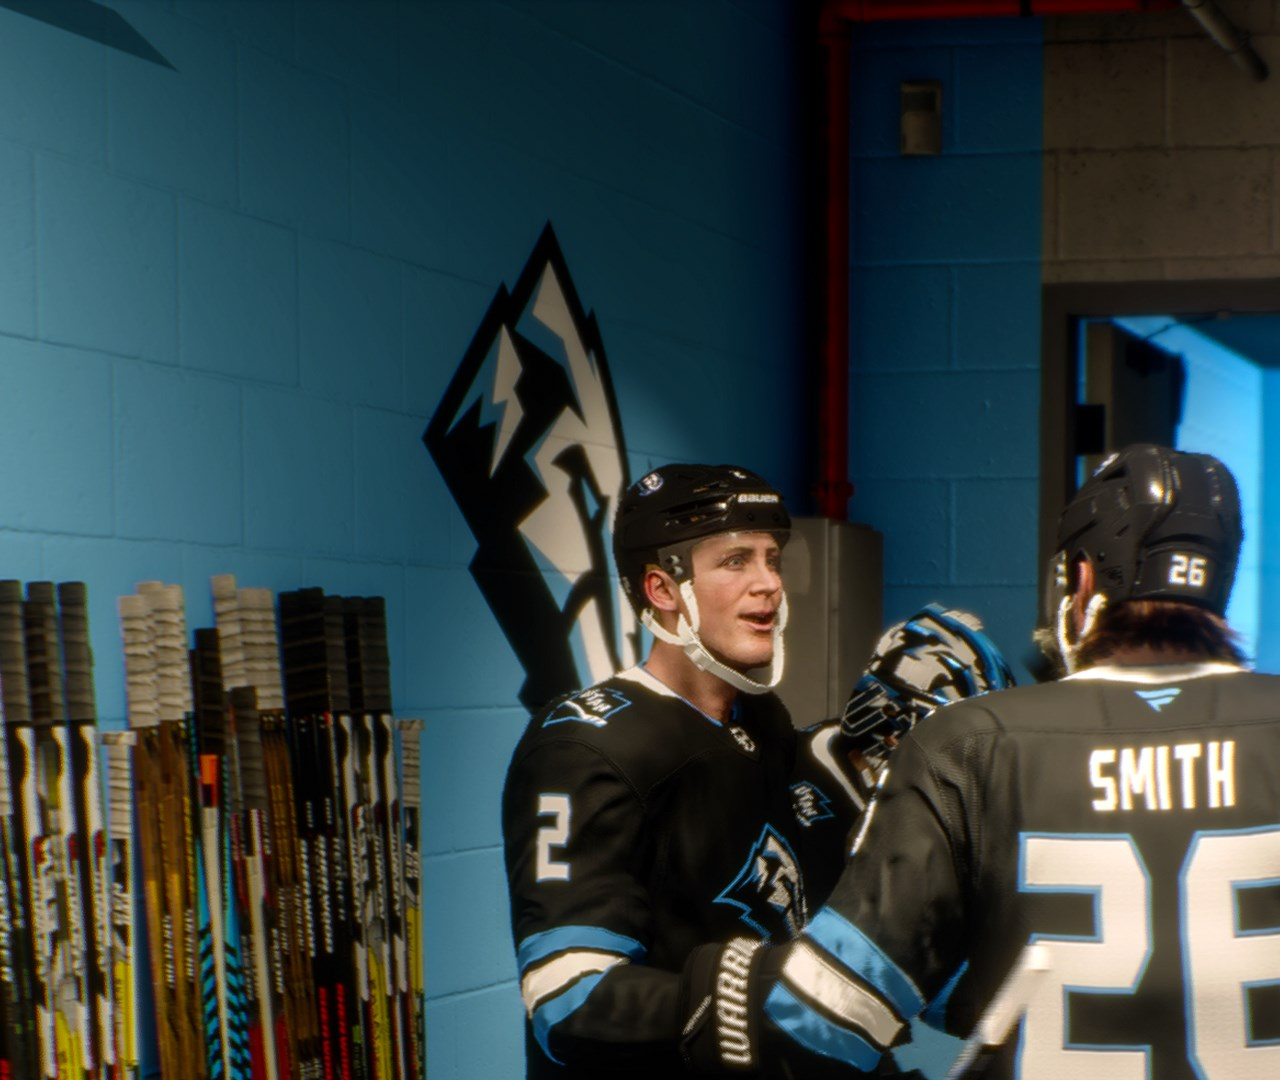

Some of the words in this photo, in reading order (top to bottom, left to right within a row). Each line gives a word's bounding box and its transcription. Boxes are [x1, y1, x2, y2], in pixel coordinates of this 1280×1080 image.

[1169, 553, 1208, 587] 26
[580, 688, 613, 714] UTAH
[1088, 740, 1237, 811] SMITH
[536, 793, 572, 880] 2
